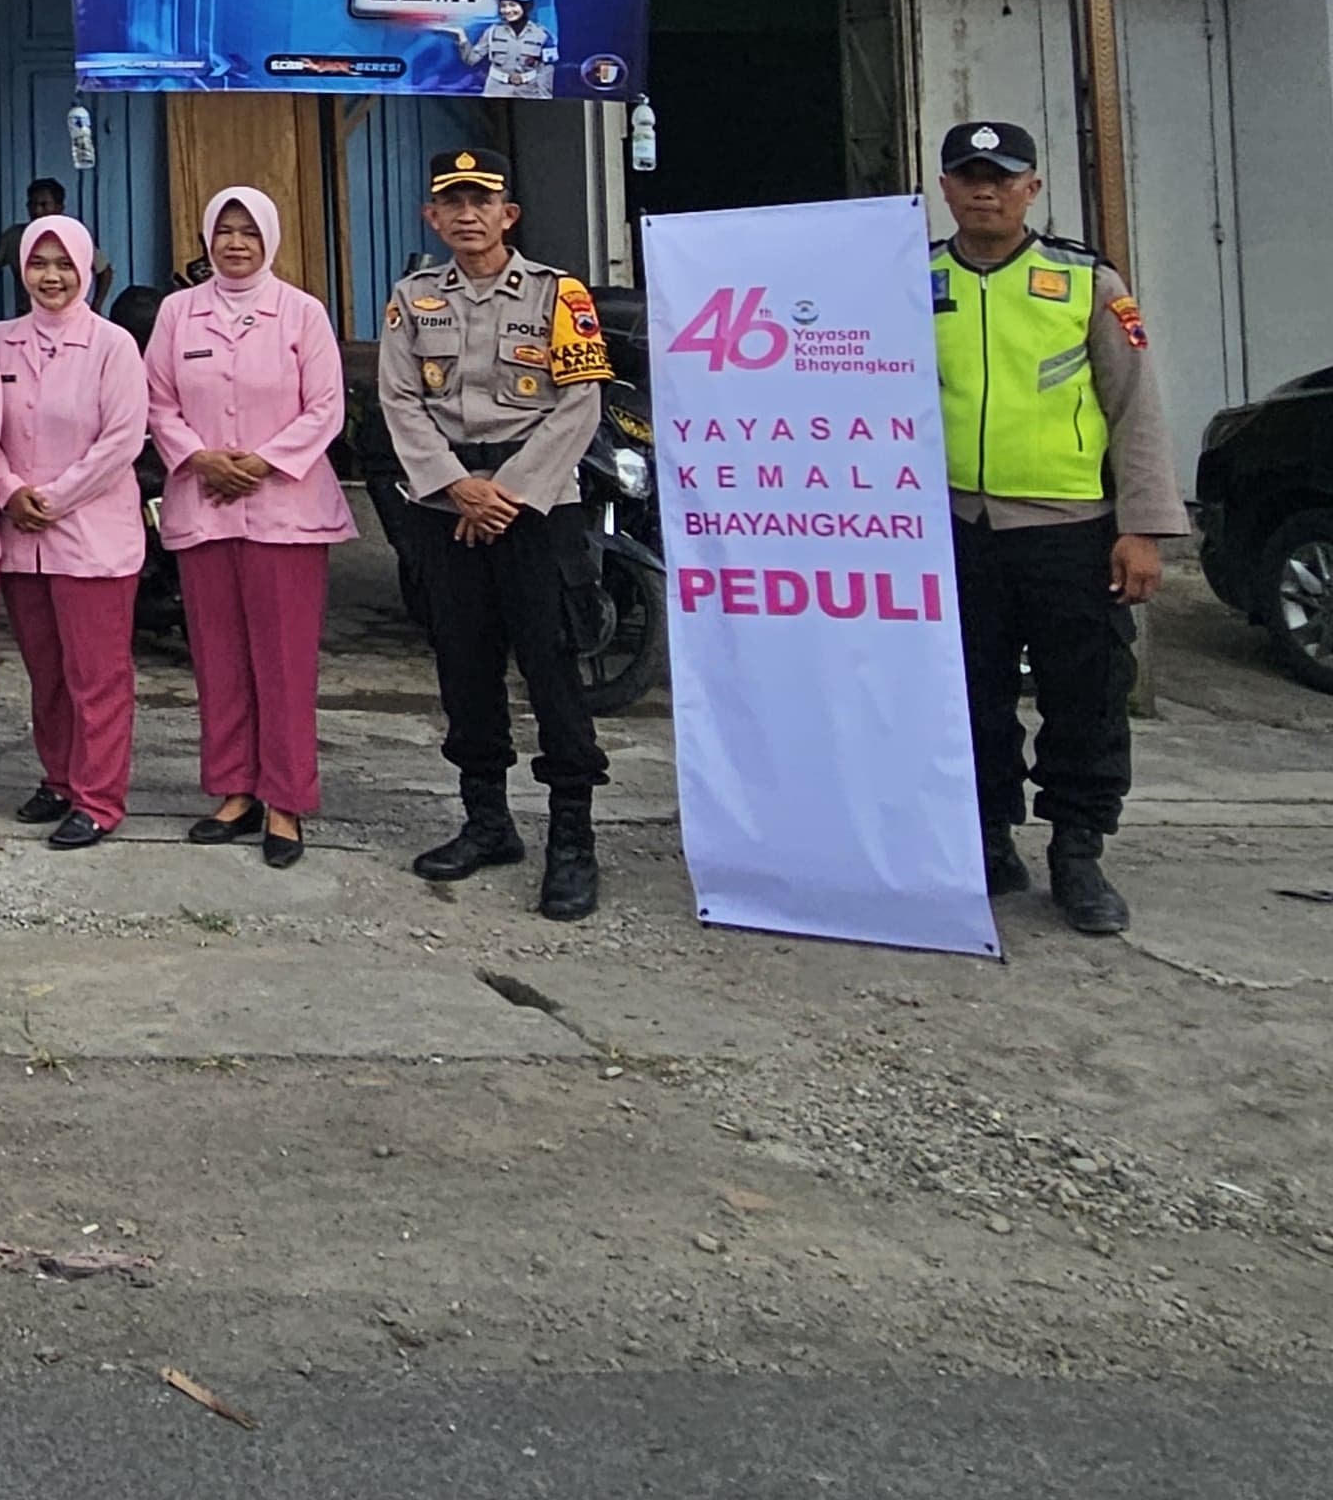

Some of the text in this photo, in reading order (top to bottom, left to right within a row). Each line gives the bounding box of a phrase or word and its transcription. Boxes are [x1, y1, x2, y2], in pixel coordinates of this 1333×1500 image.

[507, 322, 549, 338] POLR
[667, 285, 789, 373] 46
[792, 327, 871, 346] Yayasan
[794, 341, 865, 357] Kemala
[794, 357, 916, 376] Bhayangkari
[672, 416, 917, 443] YAYASAN
[678, 465, 922, 491] KEMALA
[685, 512, 924, 540] BHAYANGKARI
[678, 567, 944, 623] PEDULI
